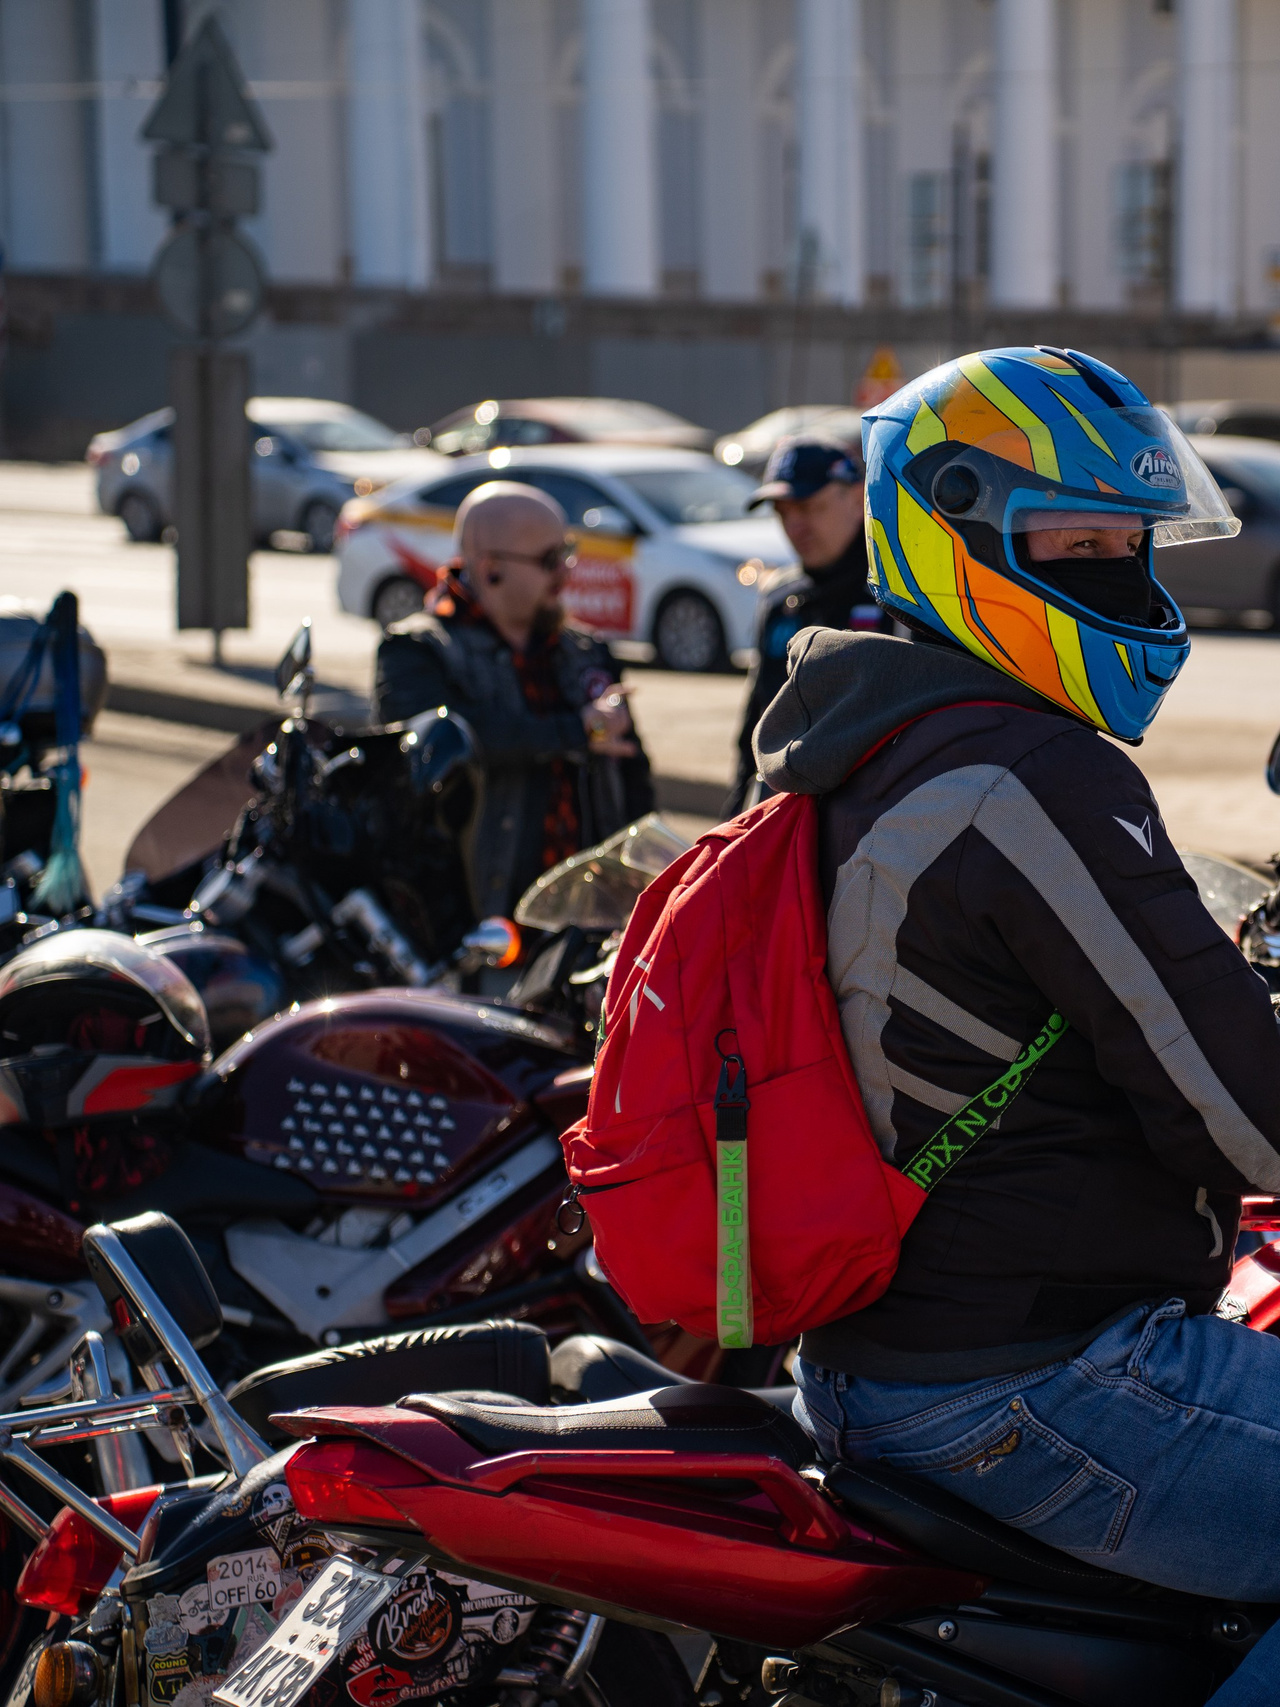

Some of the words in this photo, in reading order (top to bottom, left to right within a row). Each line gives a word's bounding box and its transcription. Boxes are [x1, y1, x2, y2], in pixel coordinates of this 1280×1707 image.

[720, 1146, 744, 1348] АЛЬФА-БАНК
[218, 1555, 267, 1580] 2014
[247, 1573, 265, 1582] RUS
[215, 1585, 246, 1605] OFF
[255, 1581, 277, 1600] 60
[376, 1575, 436, 1650] Brest
[155, 1658, 187, 1670] ROUND
